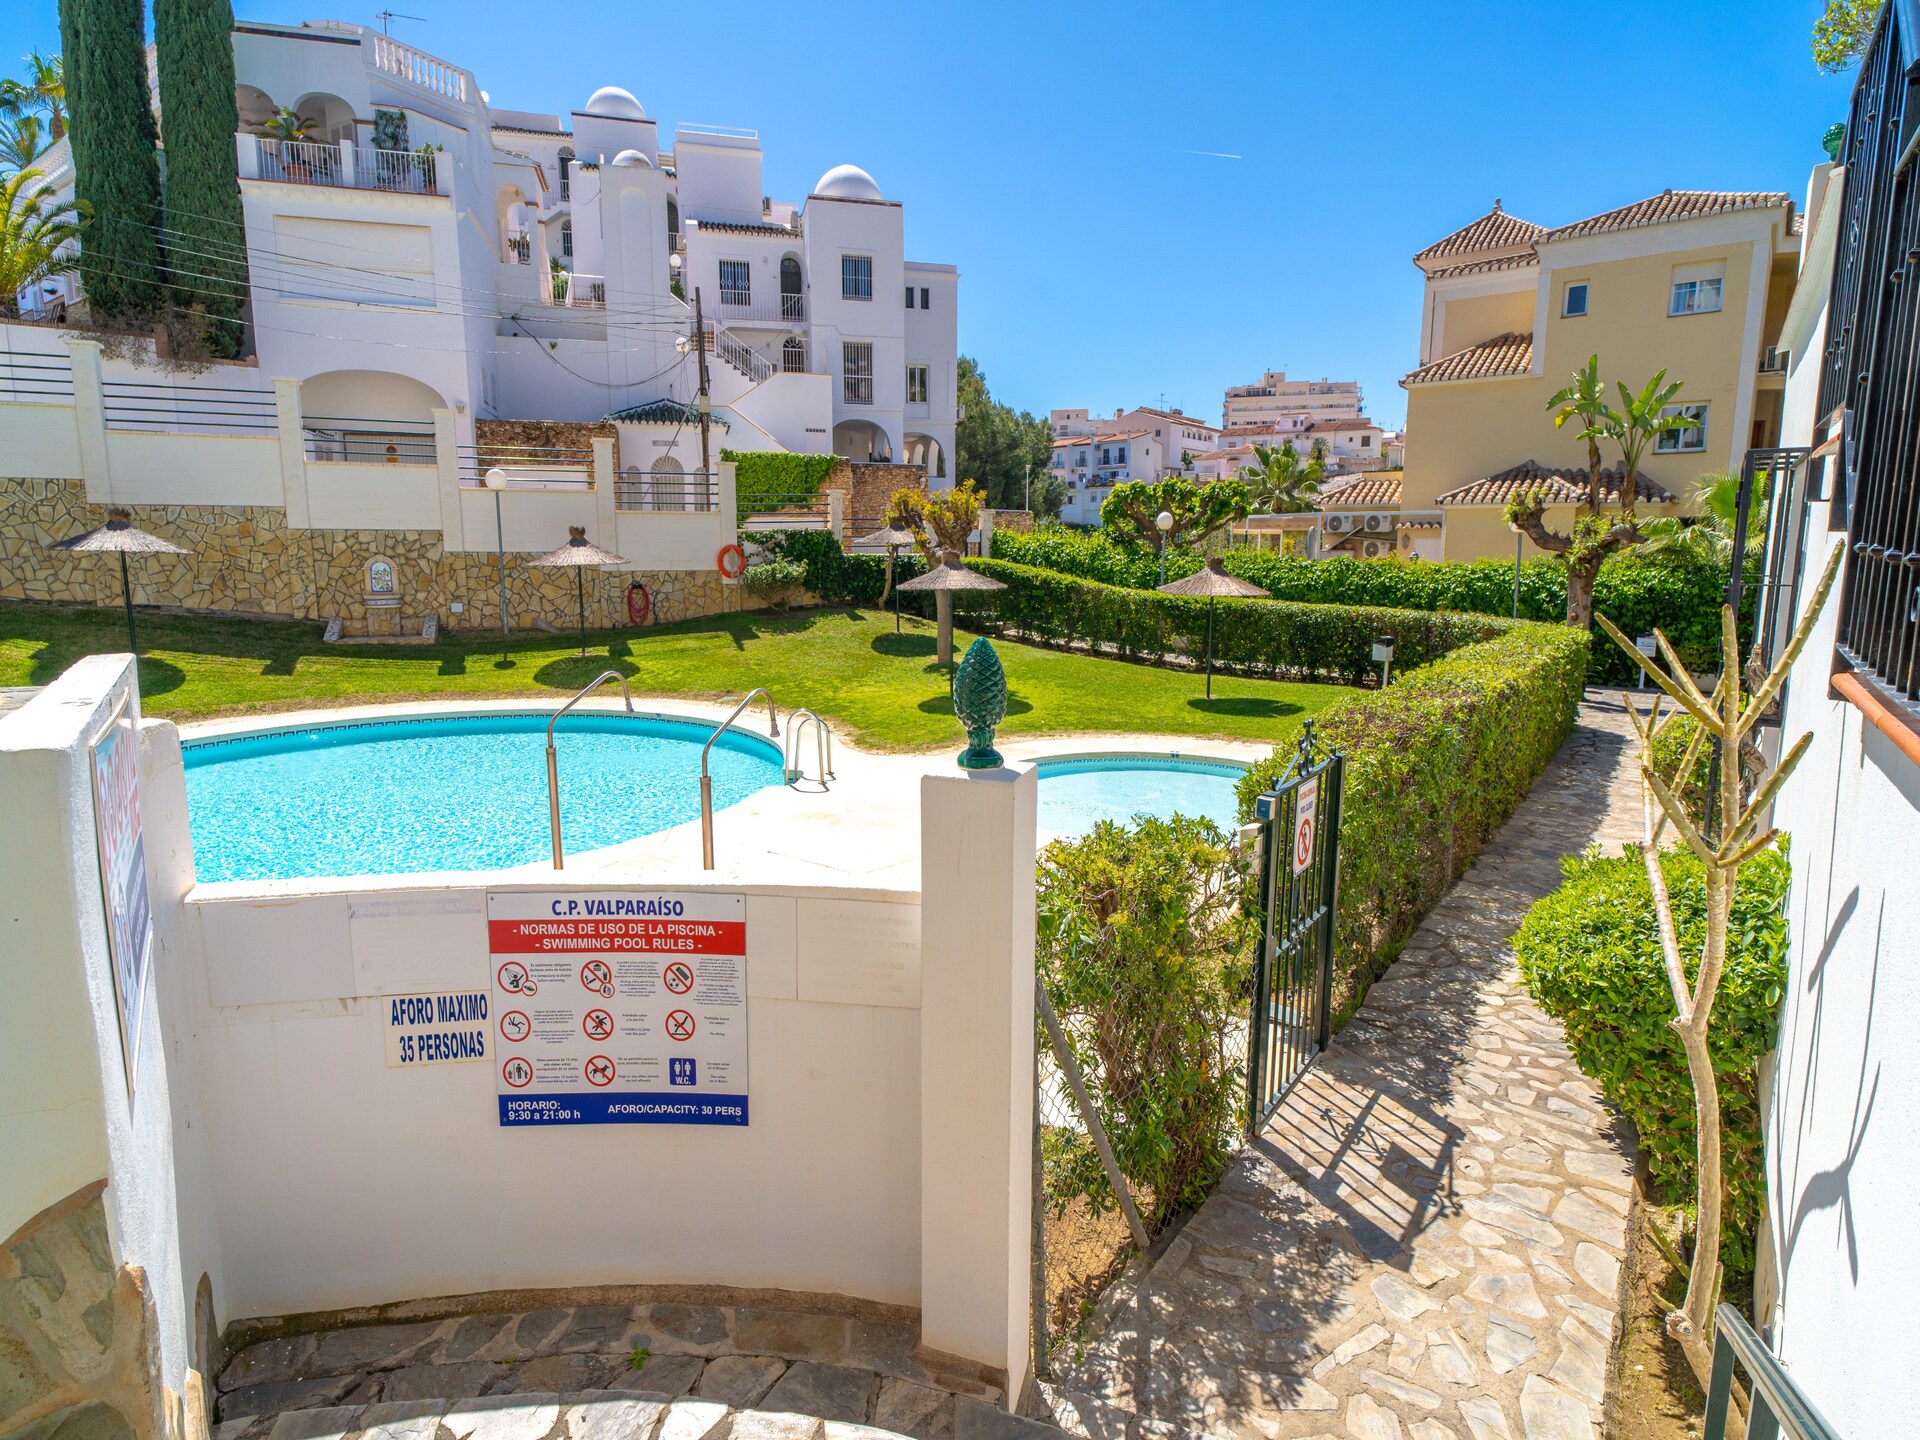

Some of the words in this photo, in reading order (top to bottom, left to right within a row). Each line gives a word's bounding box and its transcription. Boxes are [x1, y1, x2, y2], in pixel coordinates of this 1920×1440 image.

[552, 900, 581, 916] C.P.
[585, 897, 684, 916] VALPARAÍSO
[520, 924, 576, 935] NORMAS
[580, 924, 595, 935] DE
[598, 924, 626, 935] USO
[629, 924, 645, 935] DE
[648, 925, 665, 935] LA
[668, 925, 715, 935] PISCINA
[543, 939, 611, 948] SWIMMING
[614, 939, 650, 949] POOL
[653, 939, 694, 949] RULES
[392, 997, 433, 1026] AFORO
[438, 994, 487, 1022] MAXIMO
[400, 1036, 414, 1062] 35
[418, 1031, 484, 1061] PERSONAS
[508, 1101, 560, 1110] HORARIO:
[608, 1105, 699, 1115] AFORO/CAPACITY:
[702, 1106, 712, 1115] 30
[715, 1107, 742, 1116] PERS
